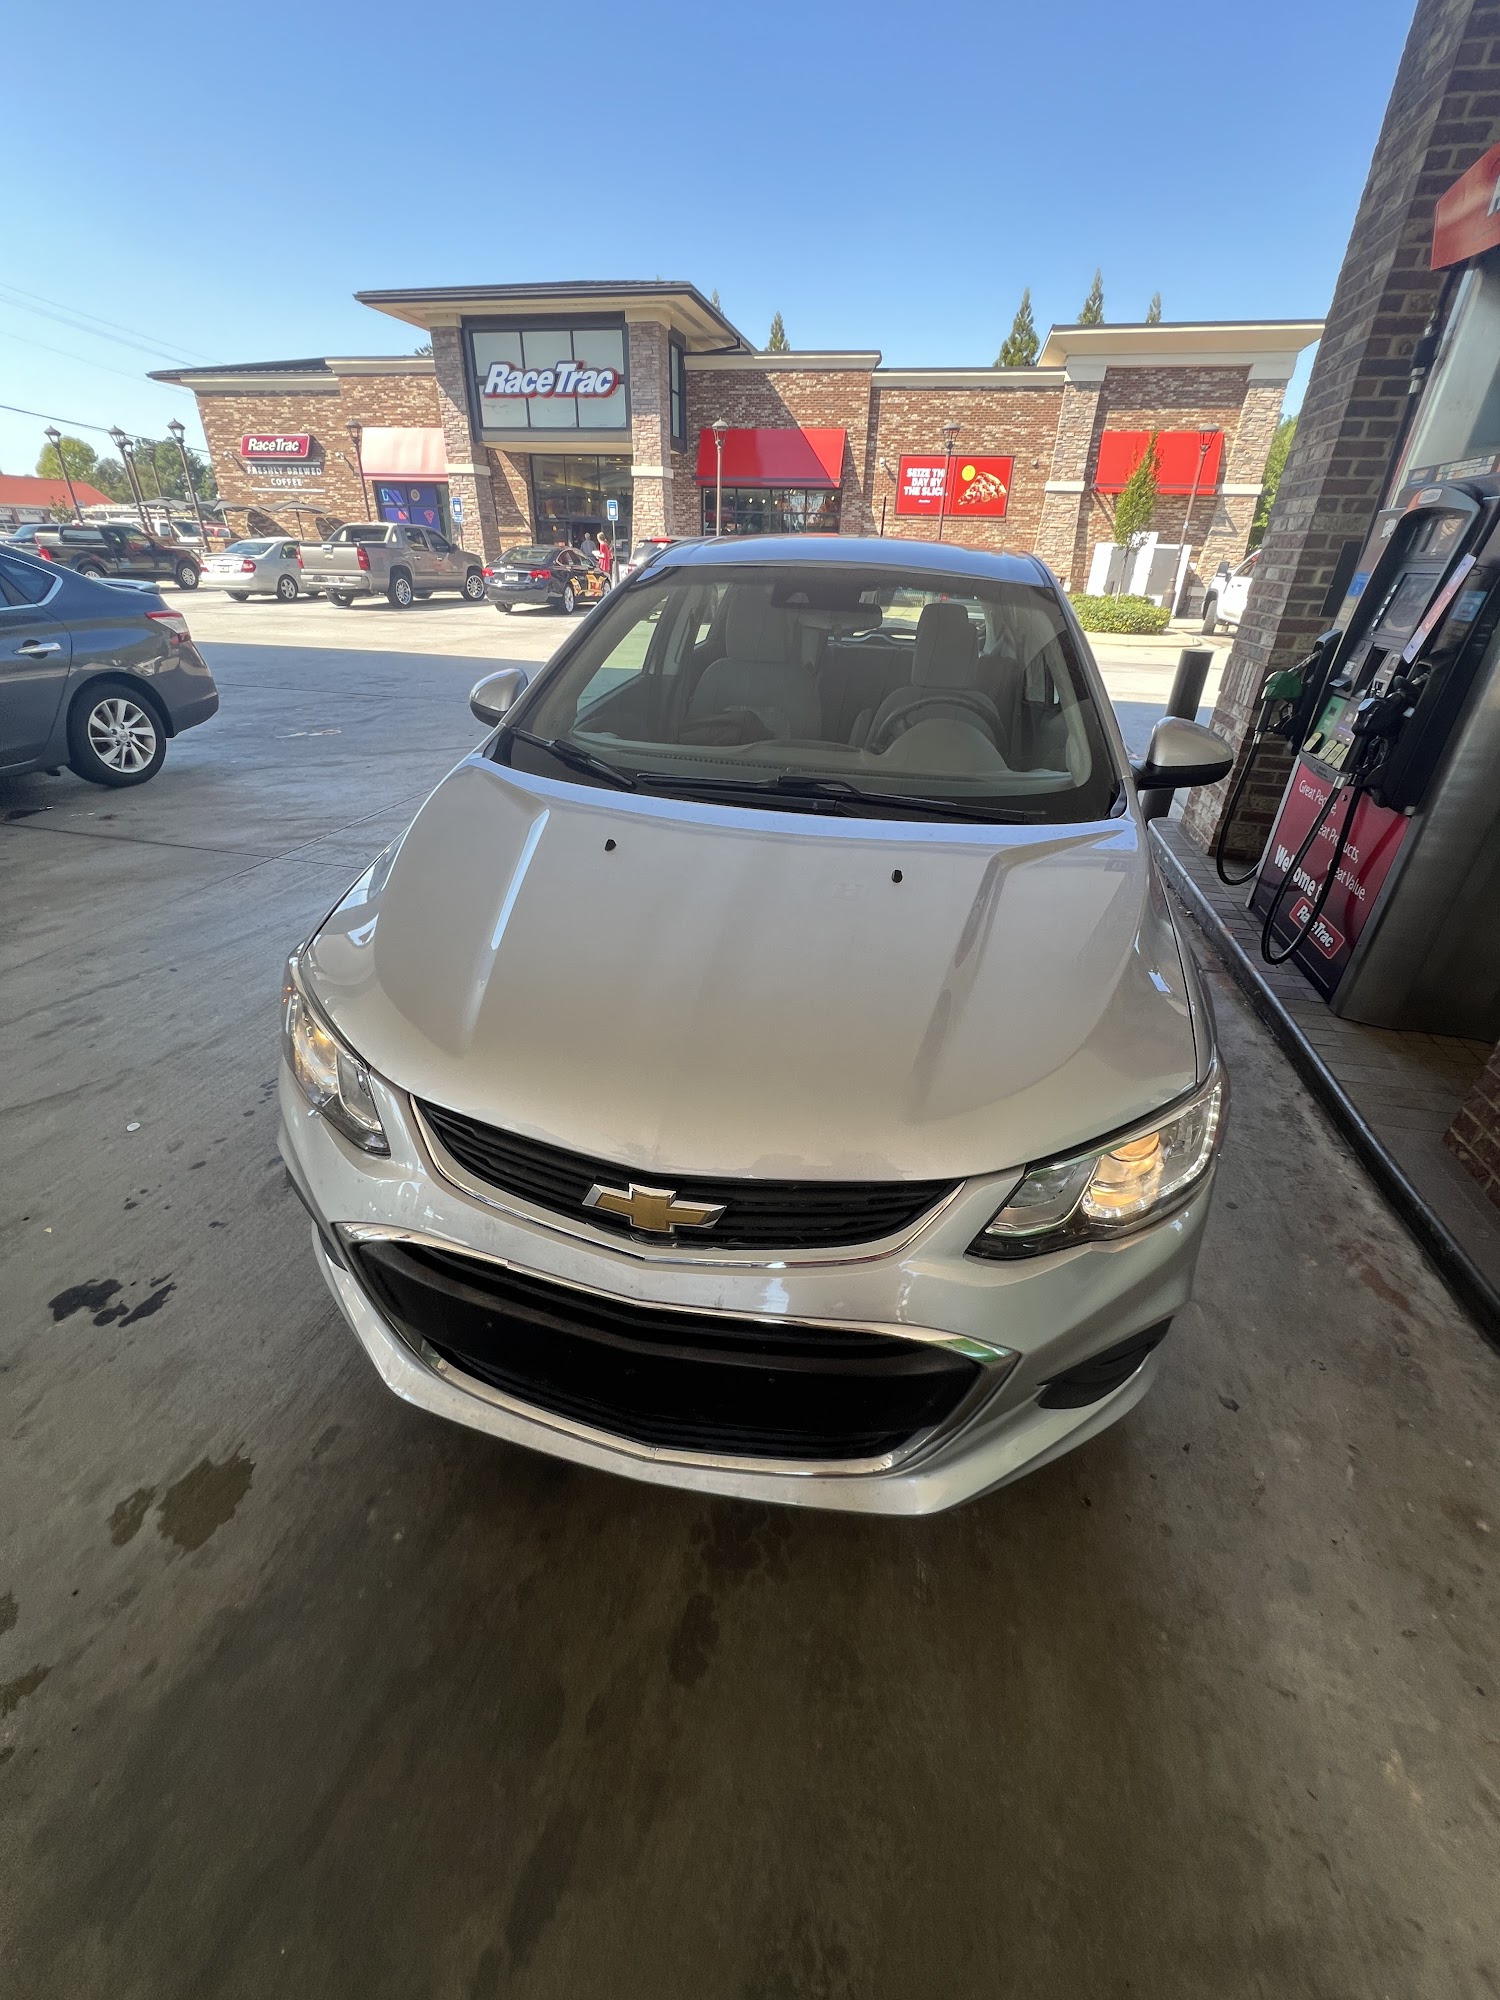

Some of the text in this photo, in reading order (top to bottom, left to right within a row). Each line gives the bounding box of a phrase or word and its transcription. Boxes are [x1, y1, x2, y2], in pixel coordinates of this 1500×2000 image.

[484, 361, 618, 397] RaceTrac
[247, 438, 300, 452] RaceTrac
[246, 465, 322, 476] FRESHLY BREWED
[906, 467, 946, 478] SEIZE TH
[270, 478, 304, 487] COFFEE
[903, 486, 921, 496] THE
[911, 477, 943, 487] DAY BY
[1298, 779, 1316, 801] Great
[1328, 828, 1360, 864] Proucts,
[1274, 843, 1316, 897] Welome
[1344, 871, 1366, 901] Value.
[1296, 904, 1334, 948] RaeTrac
